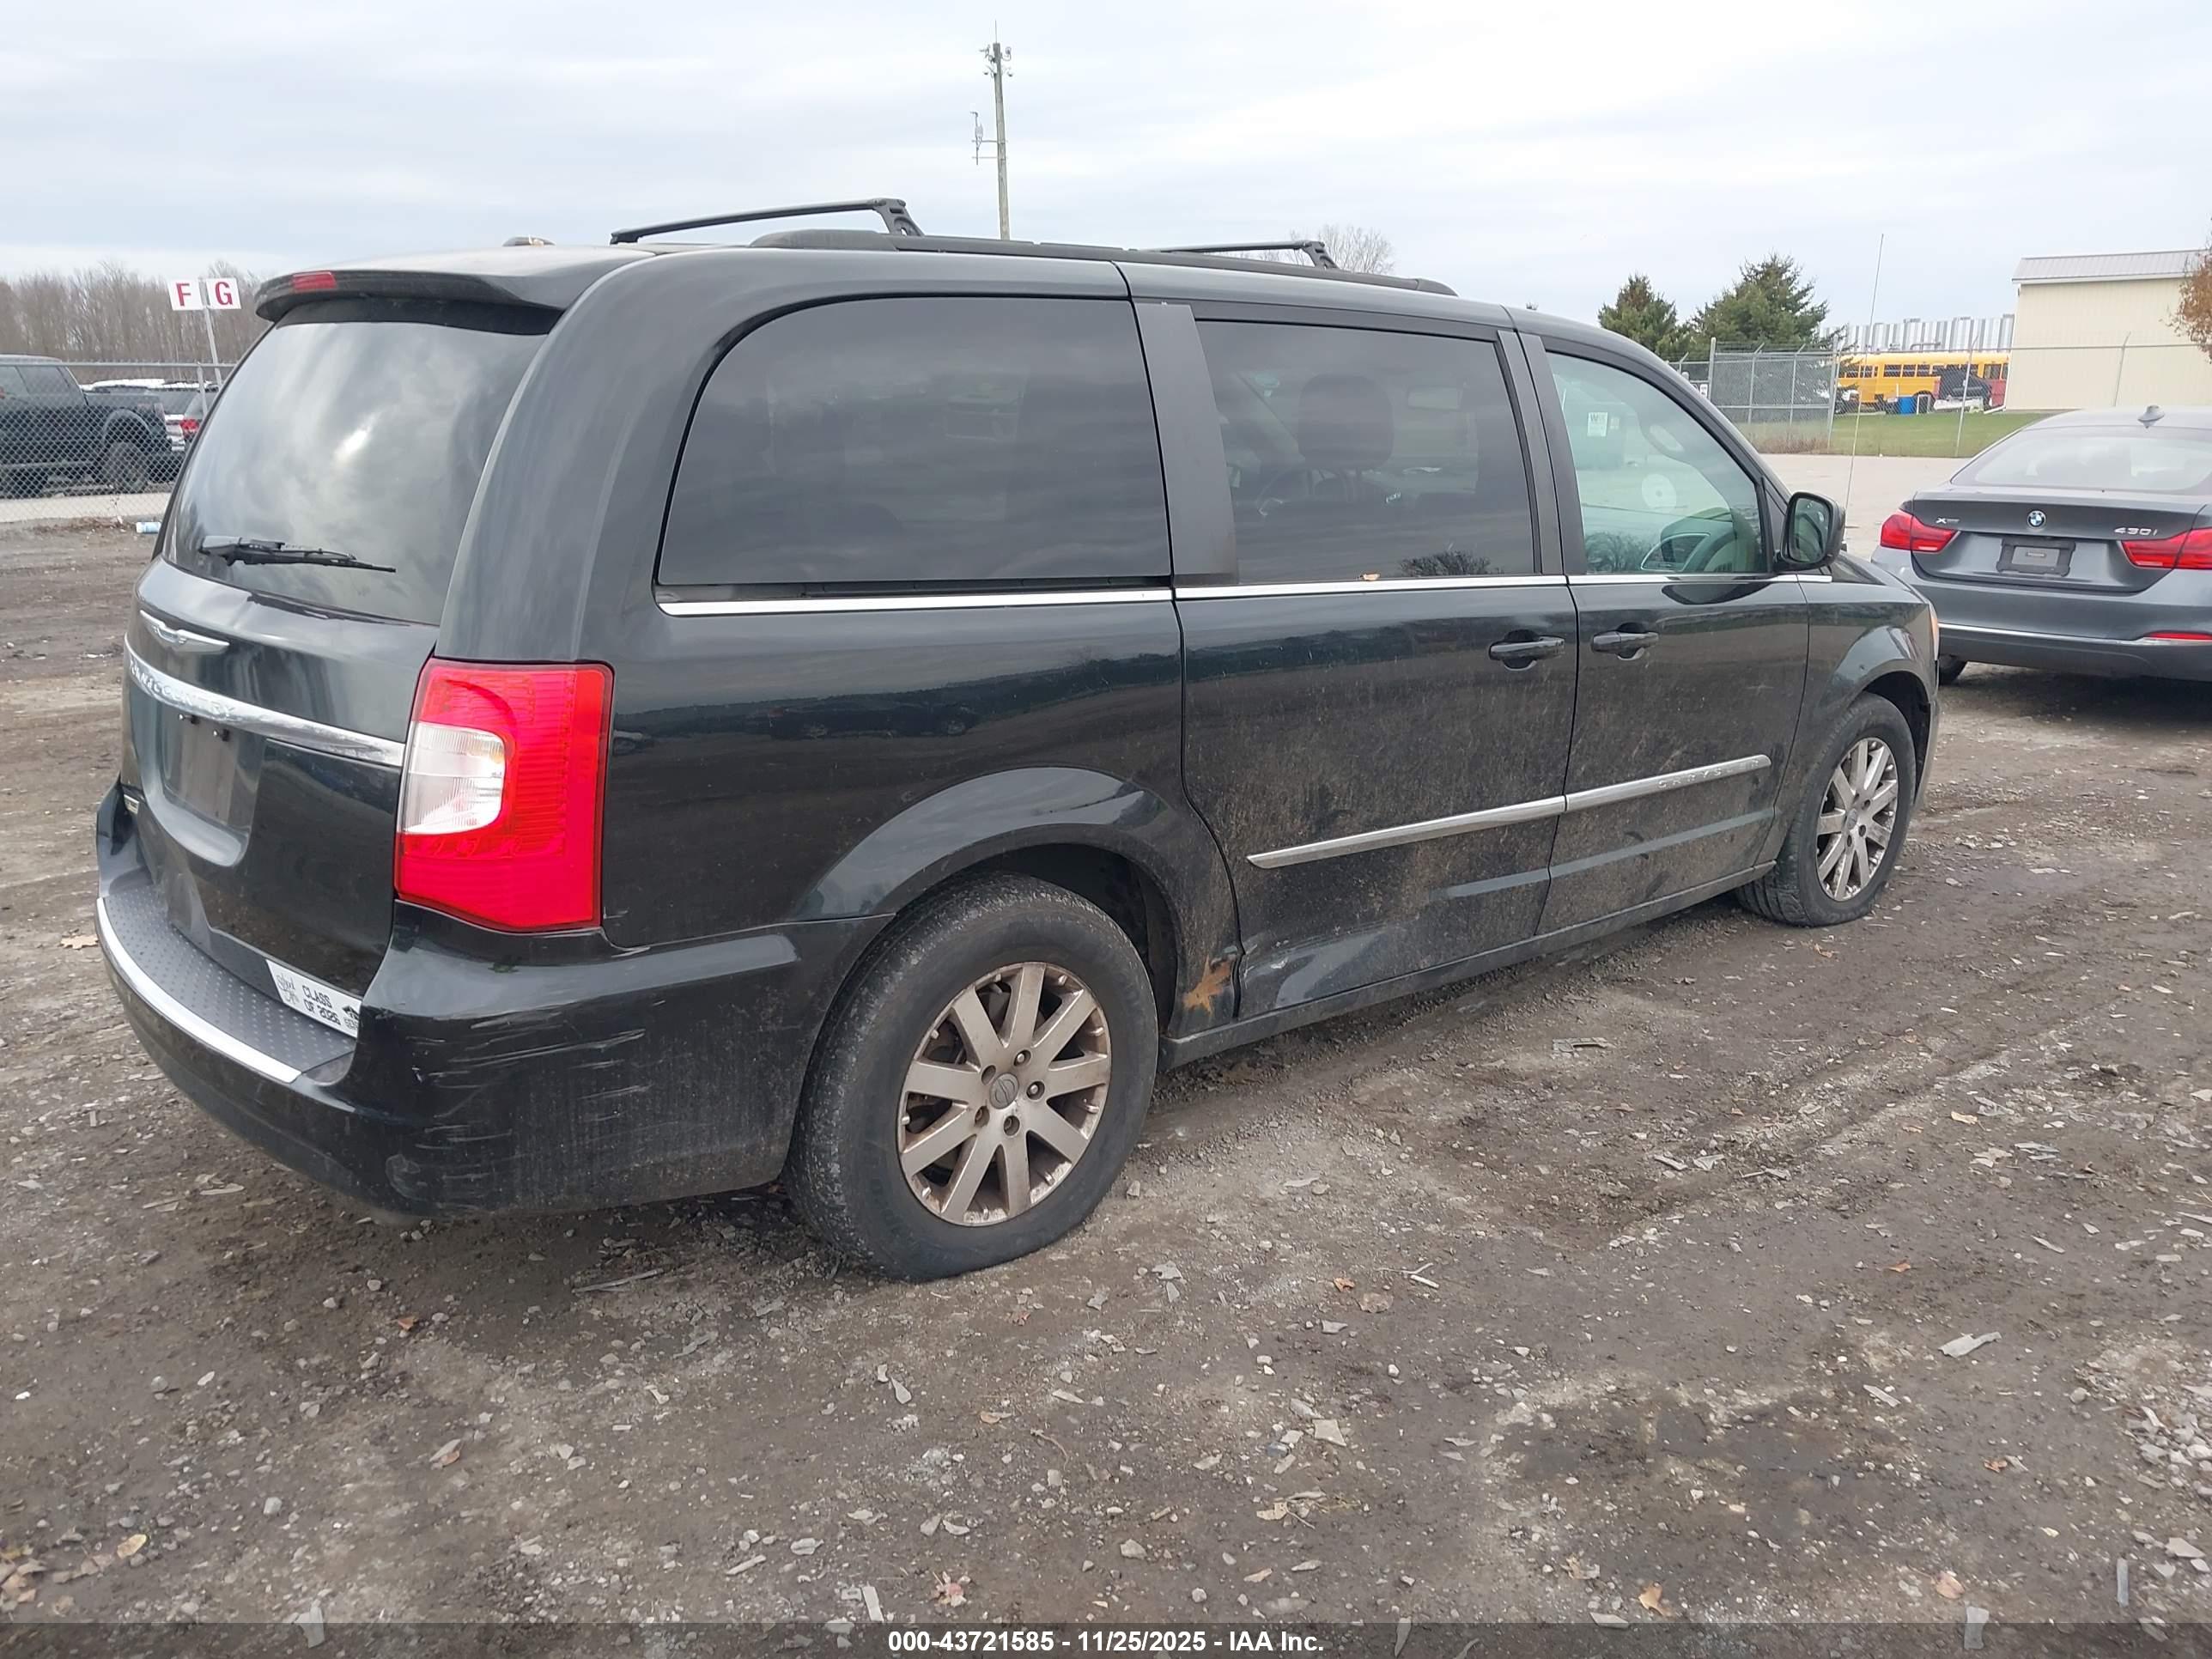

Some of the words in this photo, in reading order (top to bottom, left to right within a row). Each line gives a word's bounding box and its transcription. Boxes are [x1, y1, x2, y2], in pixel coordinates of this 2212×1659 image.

[175, 283, 191, 307] F
[215, 281, 233, 306] G
[302, 985, 332, 1009] CLASS
[304, 999, 315, 1013] OF
